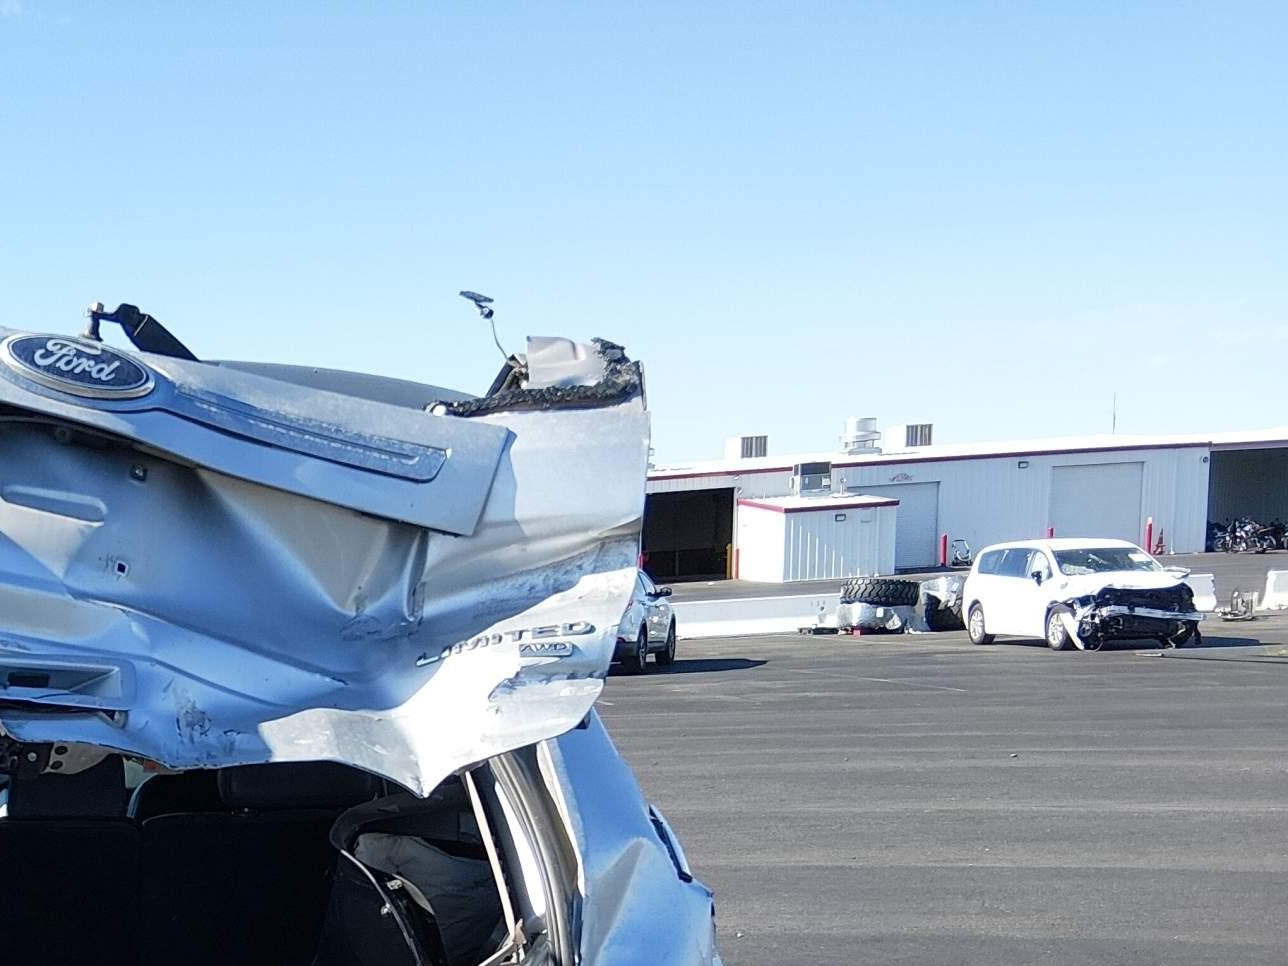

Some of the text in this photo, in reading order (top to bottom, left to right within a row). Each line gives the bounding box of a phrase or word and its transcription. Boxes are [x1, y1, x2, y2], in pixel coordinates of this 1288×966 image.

[34, 339, 120, 381] Ford
[415, 620, 596, 667] LIMITED
[520, 642, 569, 654] AWD
